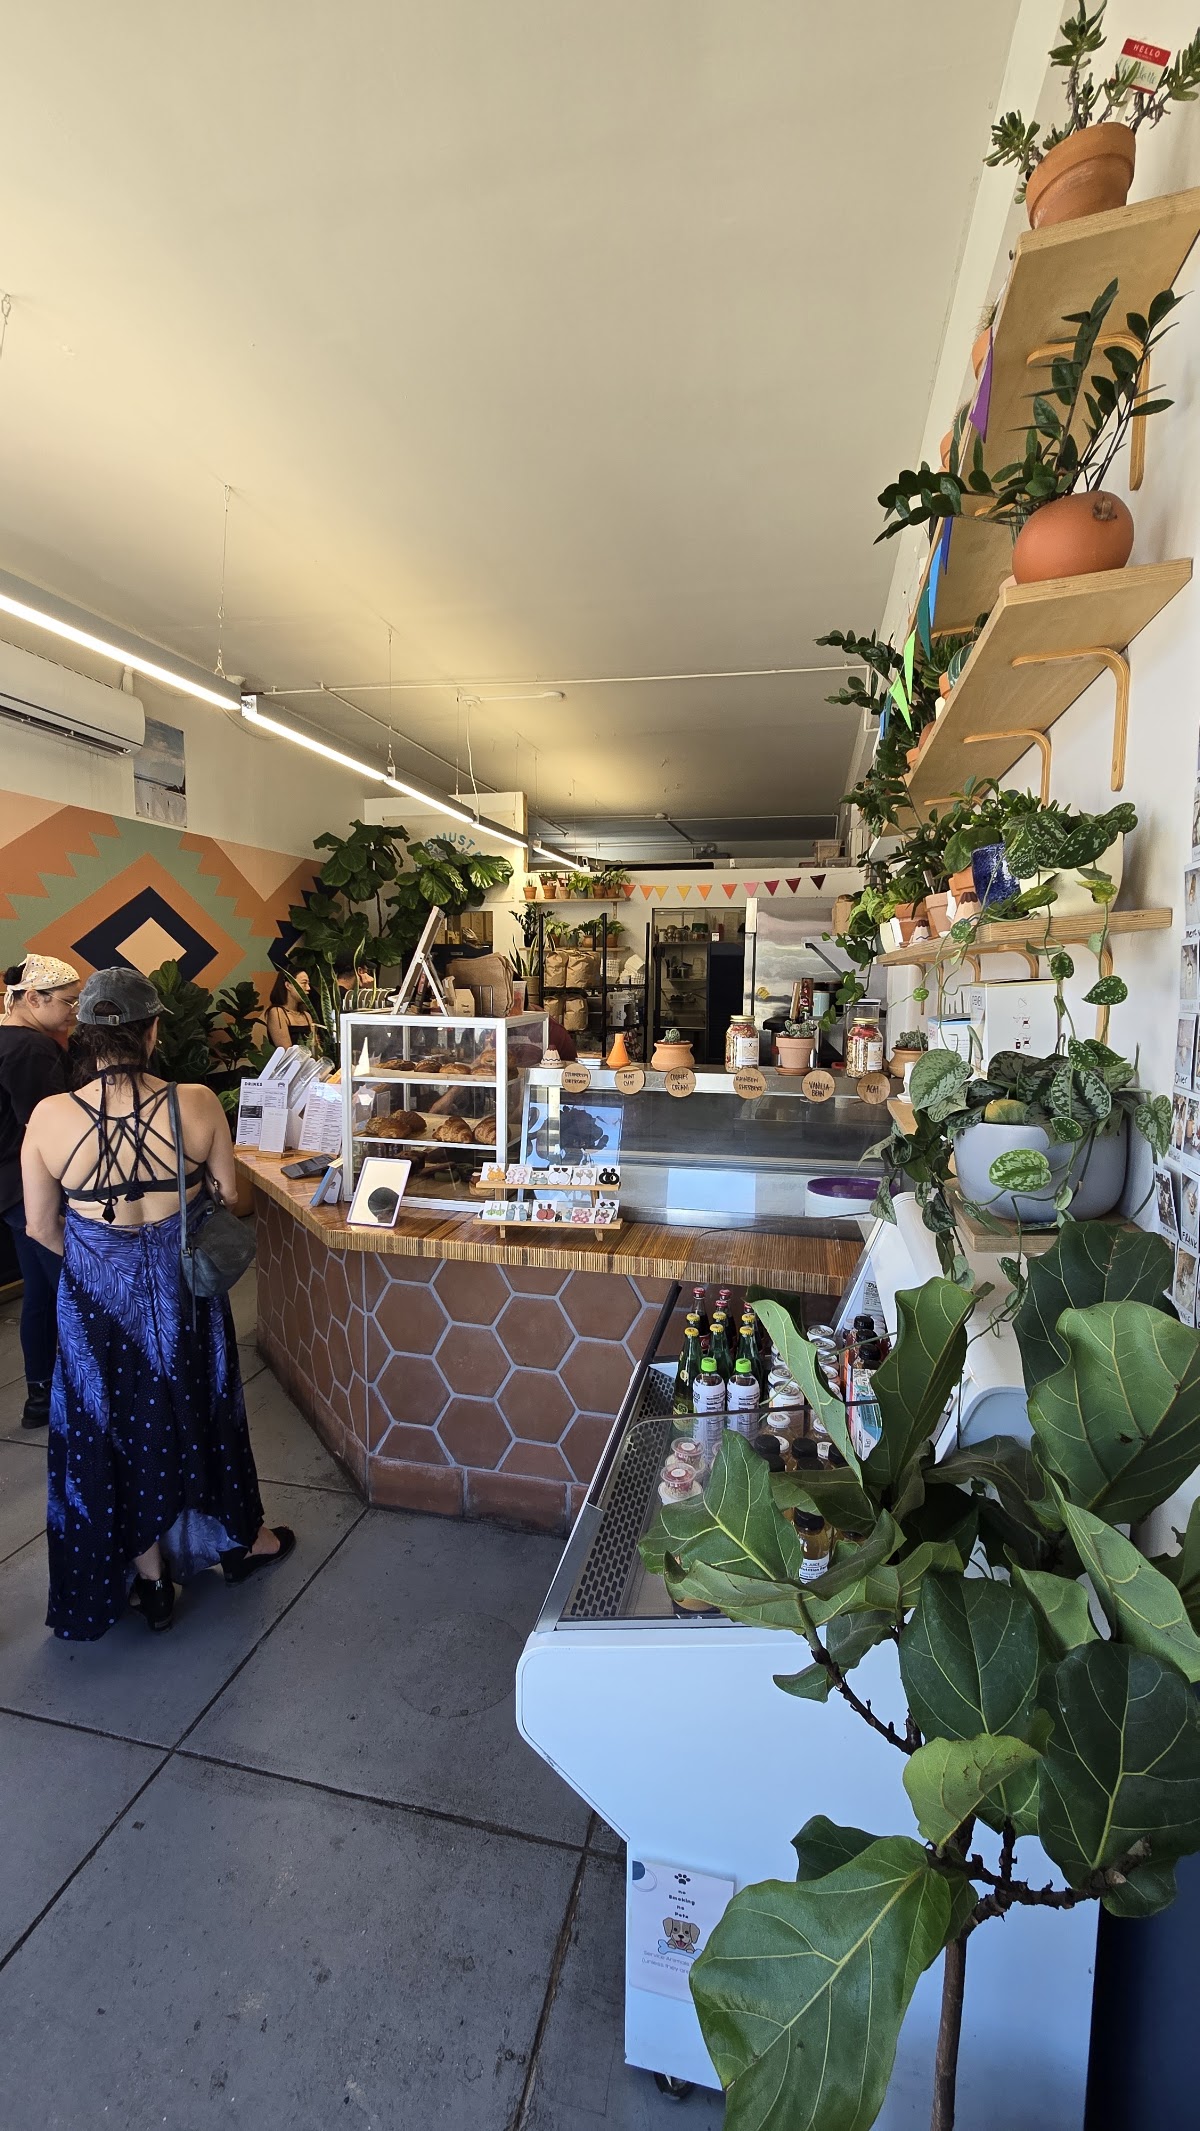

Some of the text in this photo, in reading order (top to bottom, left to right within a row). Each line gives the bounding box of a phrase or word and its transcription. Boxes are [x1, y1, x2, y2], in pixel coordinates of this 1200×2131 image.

[1133, 44, 1161, 58] HELLO
[808, 1081, 830, 1091] VANILLA
[811, 1089, 825, 1097] BEAN
[1182, 1231, 1198, 1249] FRANK
[668, 1894, 696, 1906] Smoking
[674, 1911, 689, 1919] Pets
[643, 1950, 666, 1960] Service
[665, 1963, 679, 1972] they
